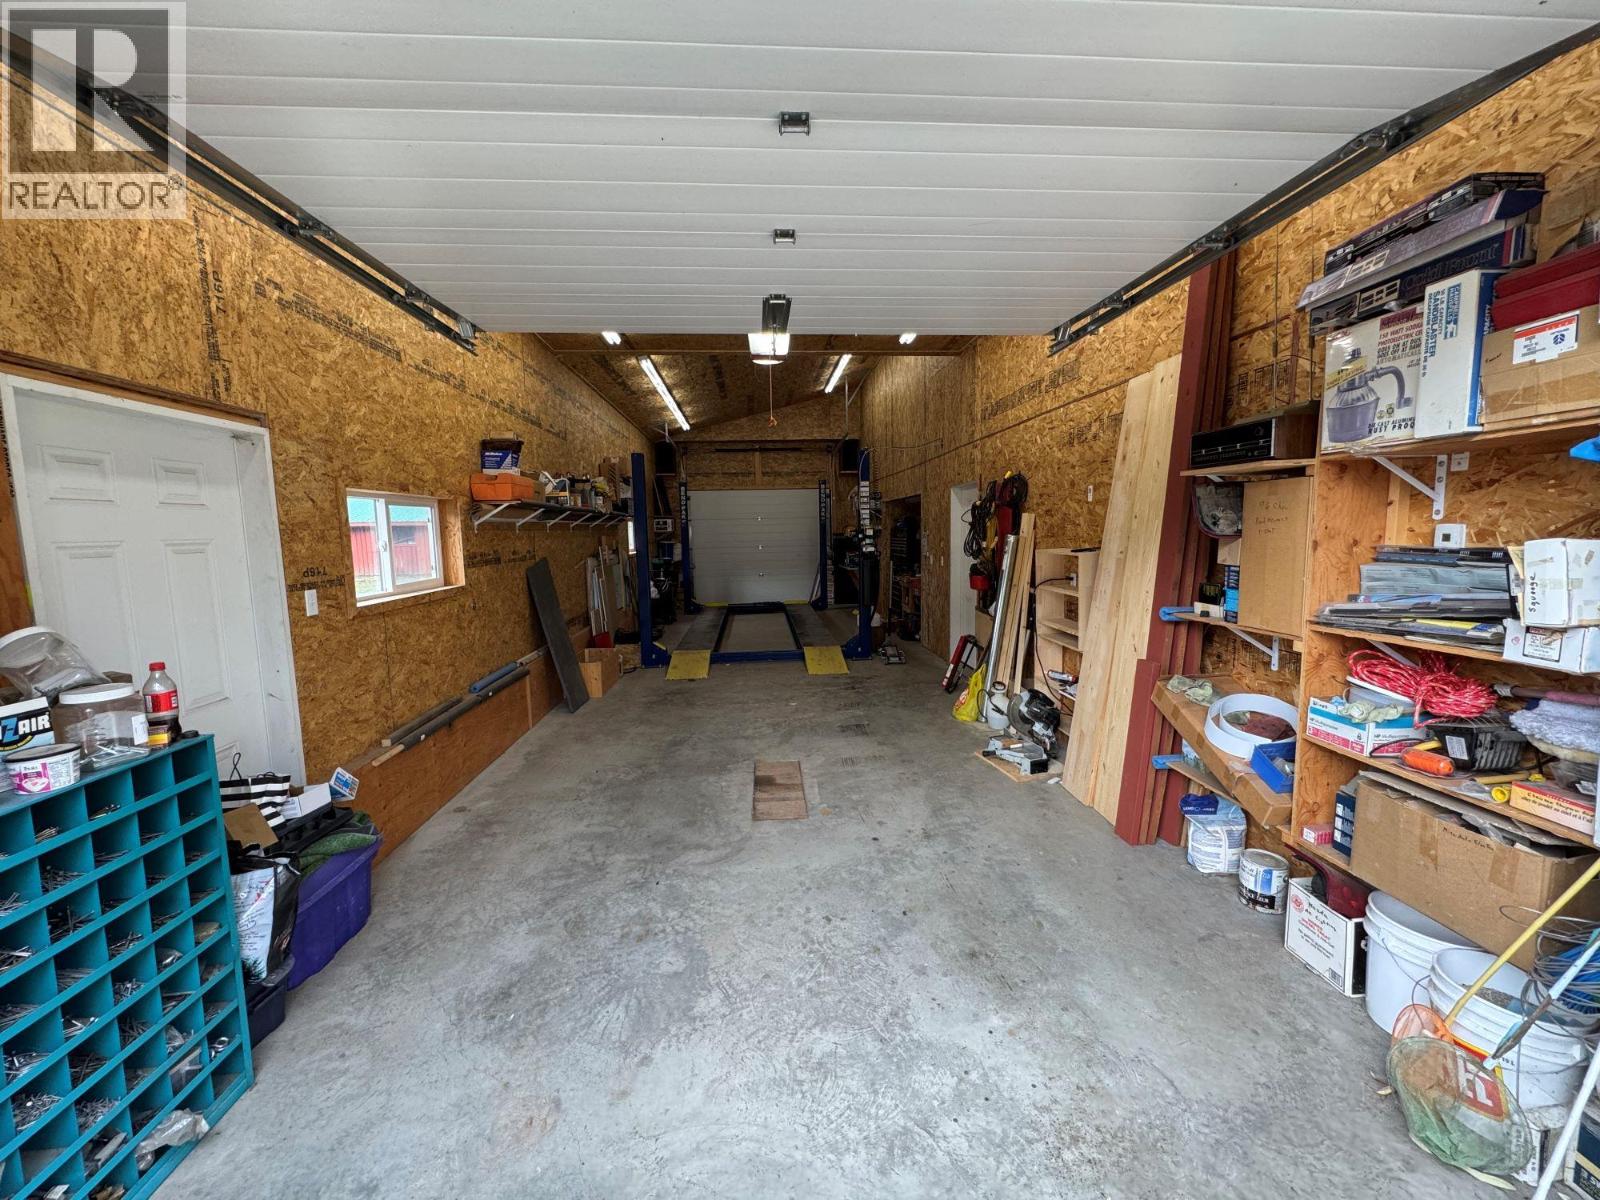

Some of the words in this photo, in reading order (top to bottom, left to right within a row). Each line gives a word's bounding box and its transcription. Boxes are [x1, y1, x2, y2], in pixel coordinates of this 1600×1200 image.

[1428, 290, 1440, 358] SANDBLASTER
[1368, 425, 1388, 435] RUST
[1392, 422, 1415, 432] PROO
